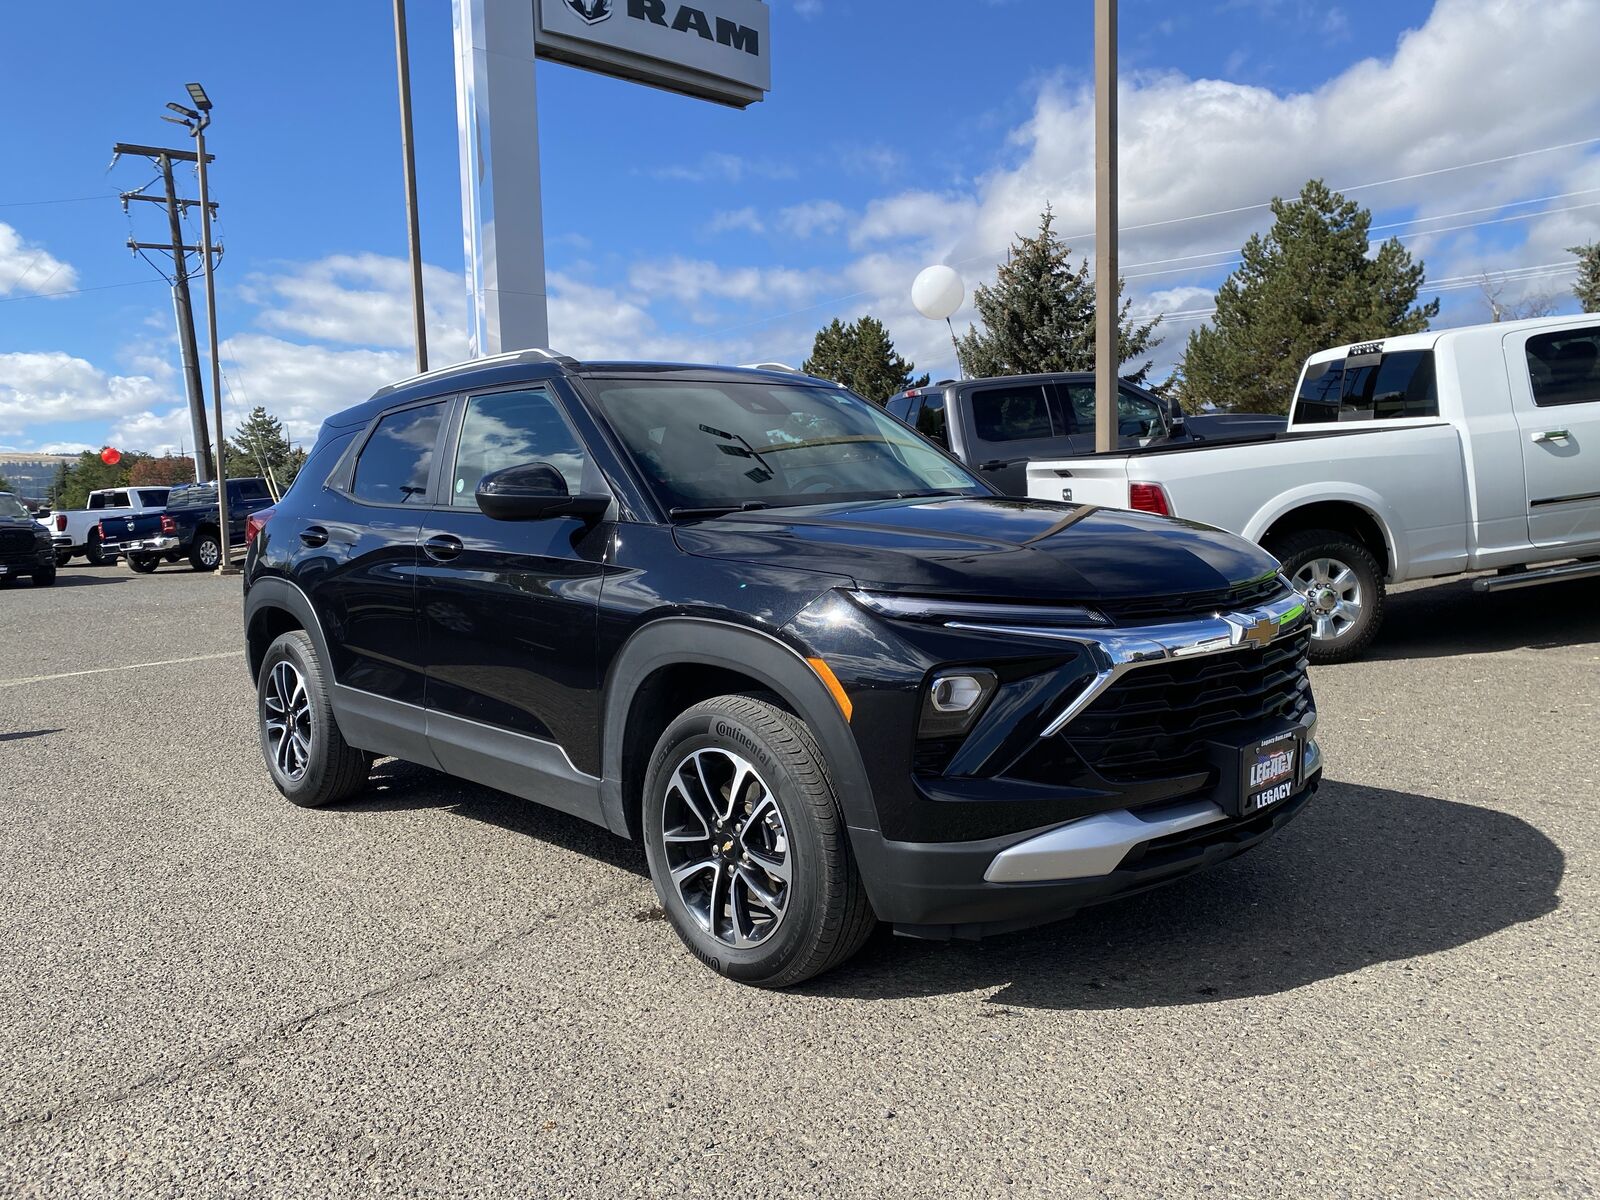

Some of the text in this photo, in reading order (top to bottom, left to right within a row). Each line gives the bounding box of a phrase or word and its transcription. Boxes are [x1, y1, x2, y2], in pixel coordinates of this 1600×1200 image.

[627, 0, 759, 56] RAM
[716, 721, 771, 766] Continental
[1250, 751, 1294, 786] LEGACY
[1257, 782, 1292, 808] LEGACY
